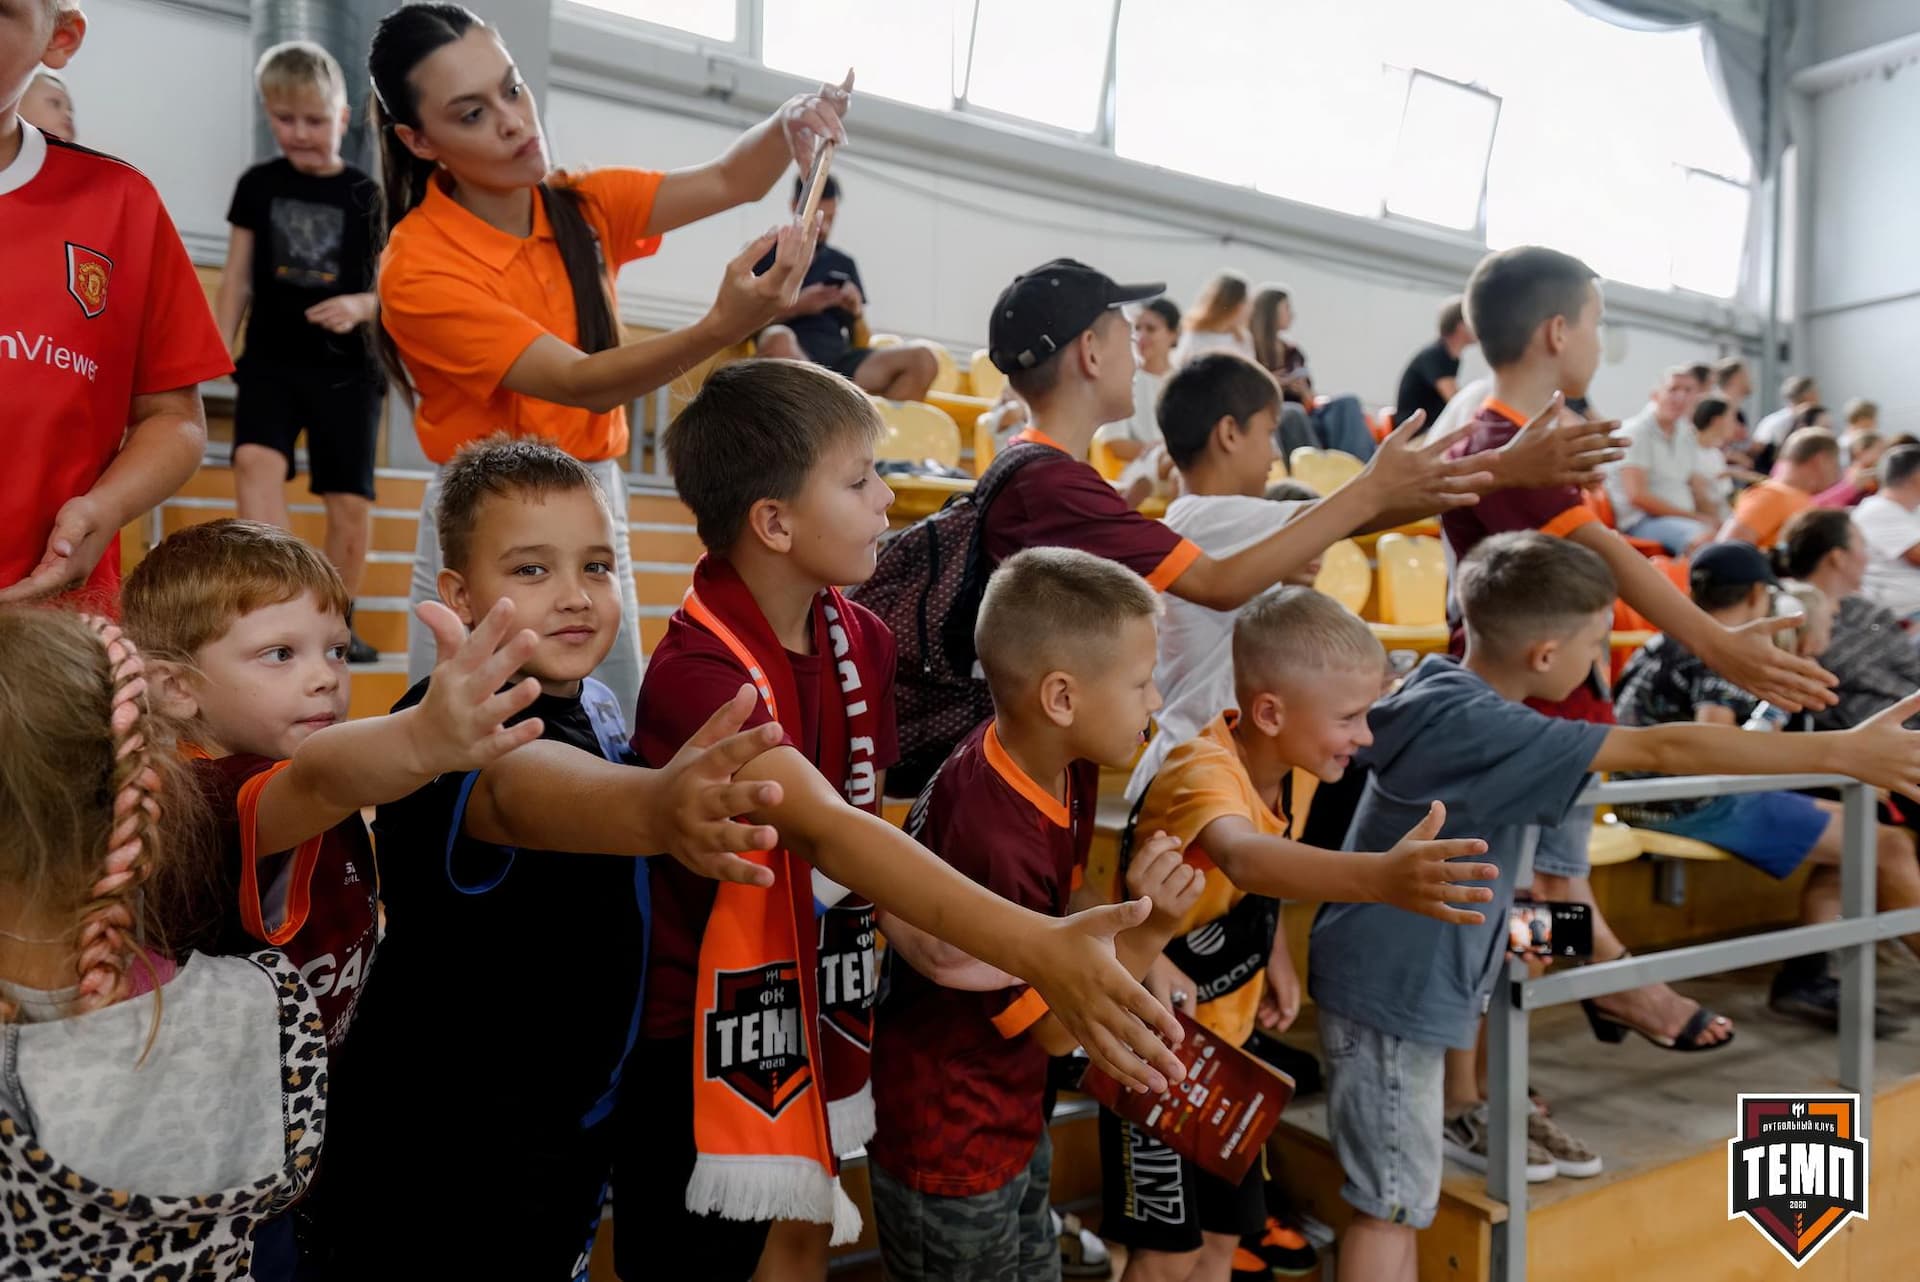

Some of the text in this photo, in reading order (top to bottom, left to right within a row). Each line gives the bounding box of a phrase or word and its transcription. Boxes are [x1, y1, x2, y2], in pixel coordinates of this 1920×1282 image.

[760, 987, 785, 1005] ФК
[716, 1008, 799, 1067] ТЕМ
[760, 1058, 785, 1070] 2020
